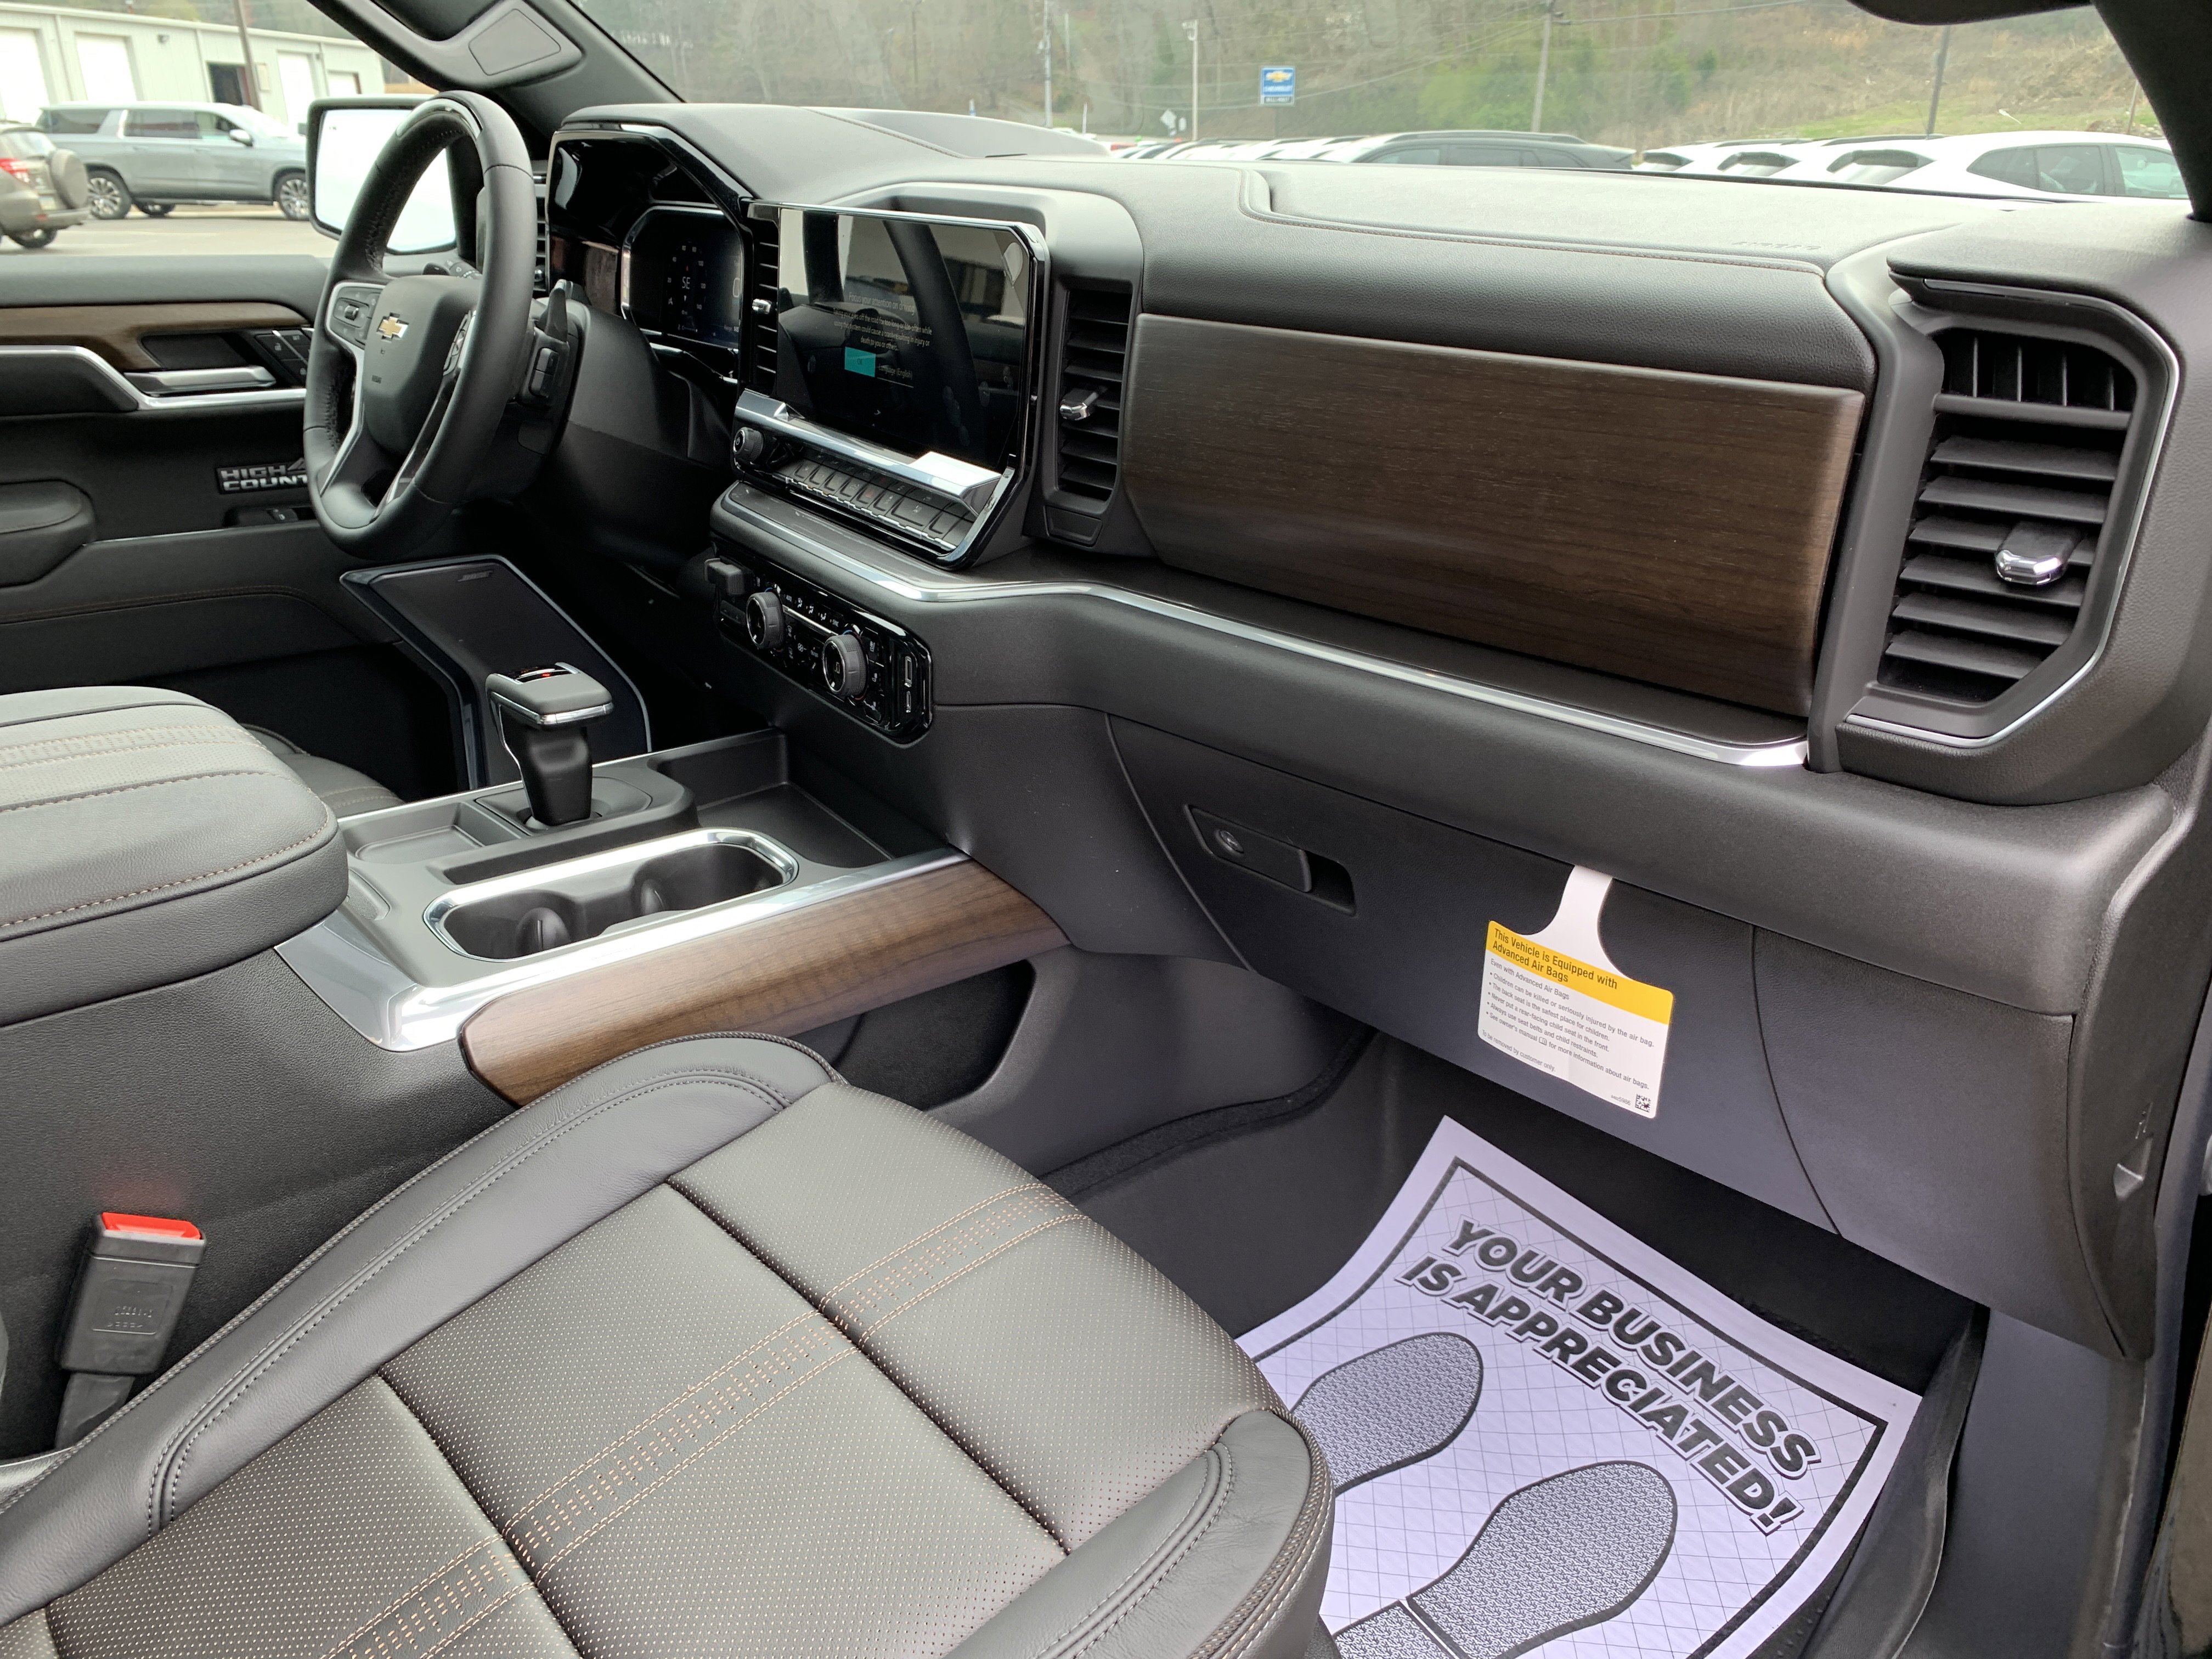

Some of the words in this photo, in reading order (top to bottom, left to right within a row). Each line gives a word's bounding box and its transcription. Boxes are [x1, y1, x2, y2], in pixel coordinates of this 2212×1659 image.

[682, 276, 691, 290] SE
[849, 292, 861, 302] Focus
[862, 297, 872, 306] your
[872, 298, 891, 308] attention
[221, 465, 286, 479] HIGH
[223, 474, 307, 491] COUNT
[1491, 958, 1502, 969] Even
[1504, 966, 1514, 975] with
[1515, 972, 1542, 989] Advanced
[1544, 985, 1553, 993] Air
[1554, 989, 1570, 1000] Bags
[1493, 941, 1530, 966] Advanced
[1531, 960, 1544, 972] Air
[1547, 966, 1568, 982] Bags
[1495, 928, 1509, 944] This
[1511, 936, 1540, 958] Vehicle
[1543, 951, 1549, 962] is
[1553, 956, 1594, 980] Equipped
[1597, 974, 1617, 989] with
[1491, 1003, 1506, 1017] Always
[1518, 1017, 1528, 1026] seat
[1530, 1023, 1543, 1033] belts
[1556, 1035, 1570, 1044] child
[1571, 1041, 1598, 1058] restraints.
[1492, 993, 1505, 1004] Never
[1519, 1008, 1548, 1026] rear-facing
[1549, 1022, 1563, 1031] child
[1565, 1027, 1576, 1037] seat
[1584, 1036, 1593, 1045] the
[1594, 1040, 1610, 1052] front.
[1494, 973, 1513, 988] Children
[1534, 993, 1549, 1004] killed
[1558, 1005, 1584, 1020] seriously
[1586, 1015, 1606, 1029] injured
[1608, 1024, 1616, 1033] by
[1618, 1028, 1627, 1037] the
[1640, 1036, 1654, 1047] bag.
[1502, 988, 1513, 998] back
[1514, 996, 1525, 1005] seat
[1532, 1003, 1541, 1011] the
[1542, 1008, 1559, 1018] safest
[1560, 1015, 1575, 1025] place
[1585, 1026, 1610, 1041] children.
[1490, 1012, 1498, 1021] See
[1499, 1019, 1517, 1031] owner's
[1519, 1029, 1537, 1041] manual
[1558, 1046, 1572, 1056] more
[1573, 1053, 1604, 1071] information
[1605, 1068, 1622, 1079] about
[1633, 1078, 1649, 1090] bags.
[1493, 1037, 1513, 1051] removed
[1514, 1047, 1519, 1056] by
[1520, 1052, 1542, 1066] customer
[1442, 1214, 1587, 1305] YOUR
[1569, 1284, 1821, 1480] BUSINESS
[1394, 1252, 1466, 1296] IS
[1440, 1279, 1804, 1536] APPRECIATED!
